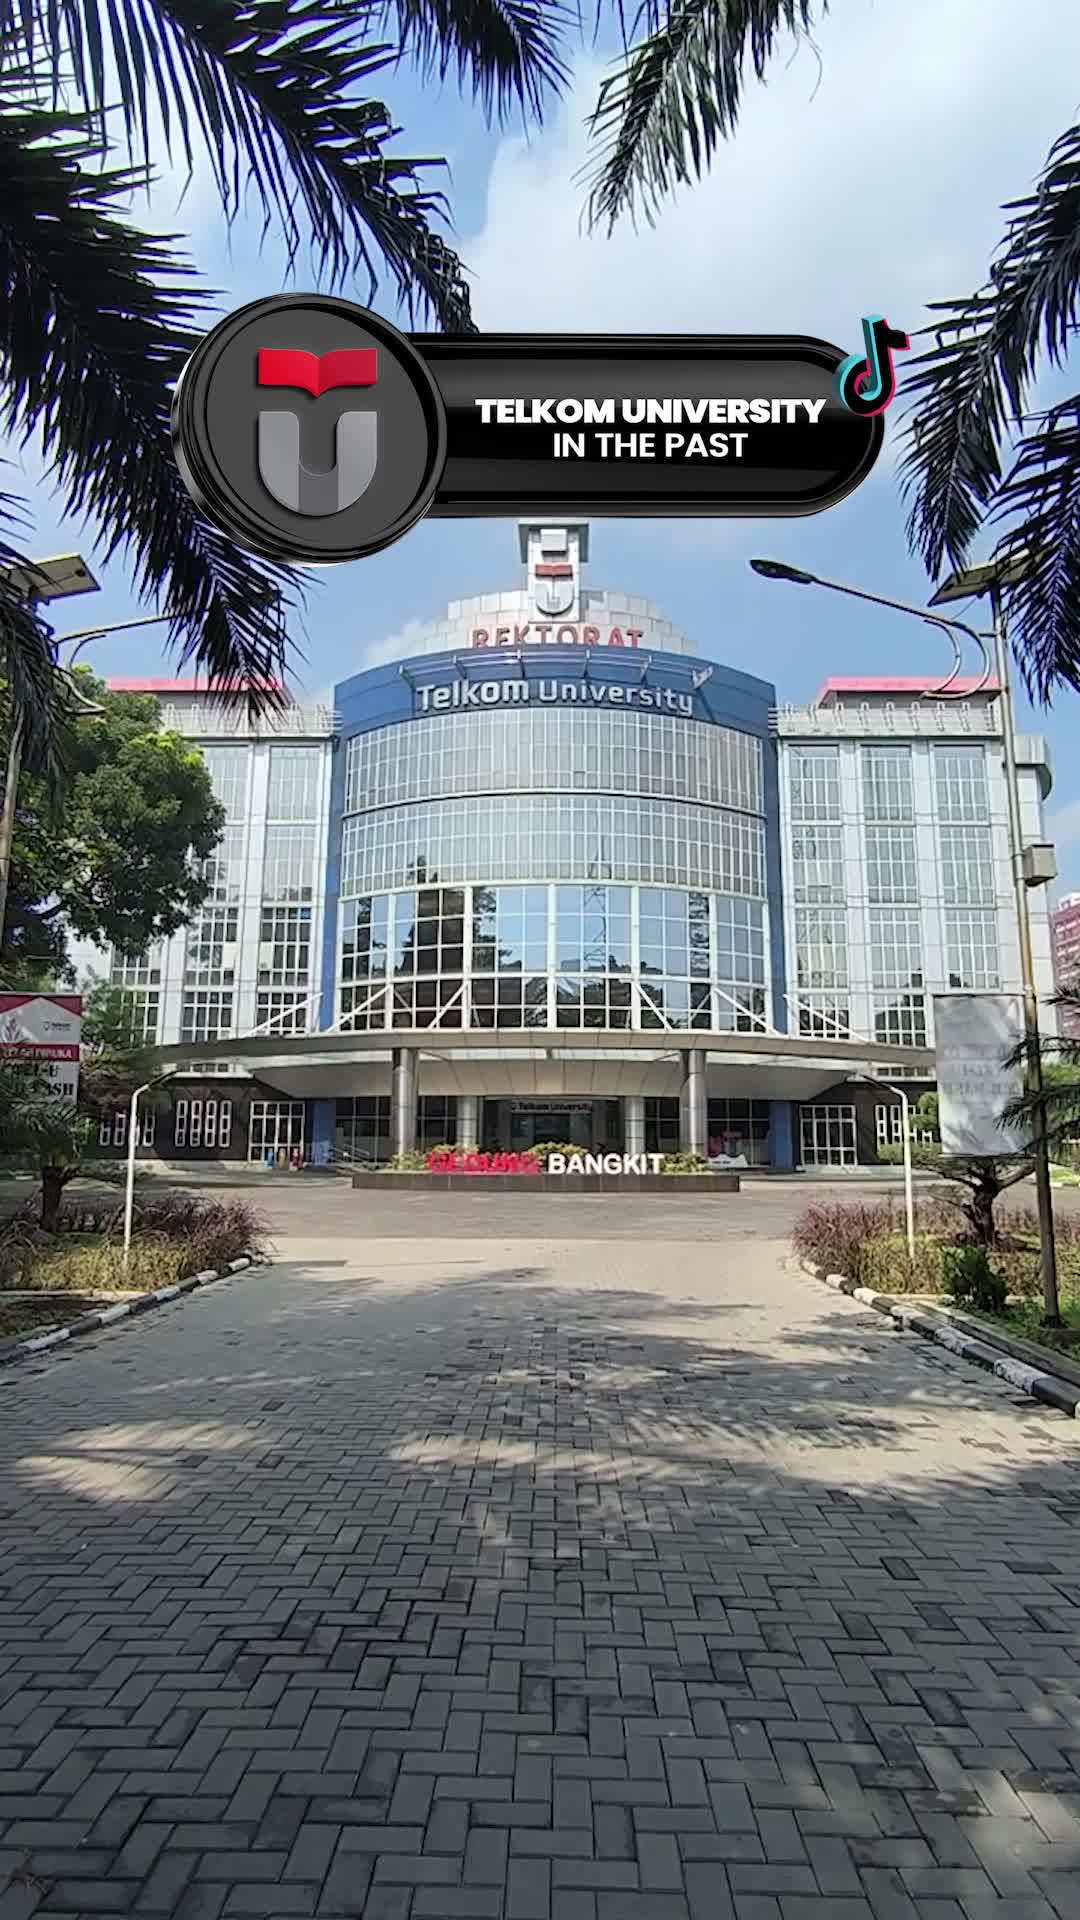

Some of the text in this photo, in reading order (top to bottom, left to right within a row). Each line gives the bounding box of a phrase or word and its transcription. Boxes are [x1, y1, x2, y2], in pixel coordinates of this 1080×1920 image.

[472, 625, 643, 649] REKTORAT
[417, 679, 693, 717] Telkom University
[548, 1152, 665, 1175] BANGKIT
